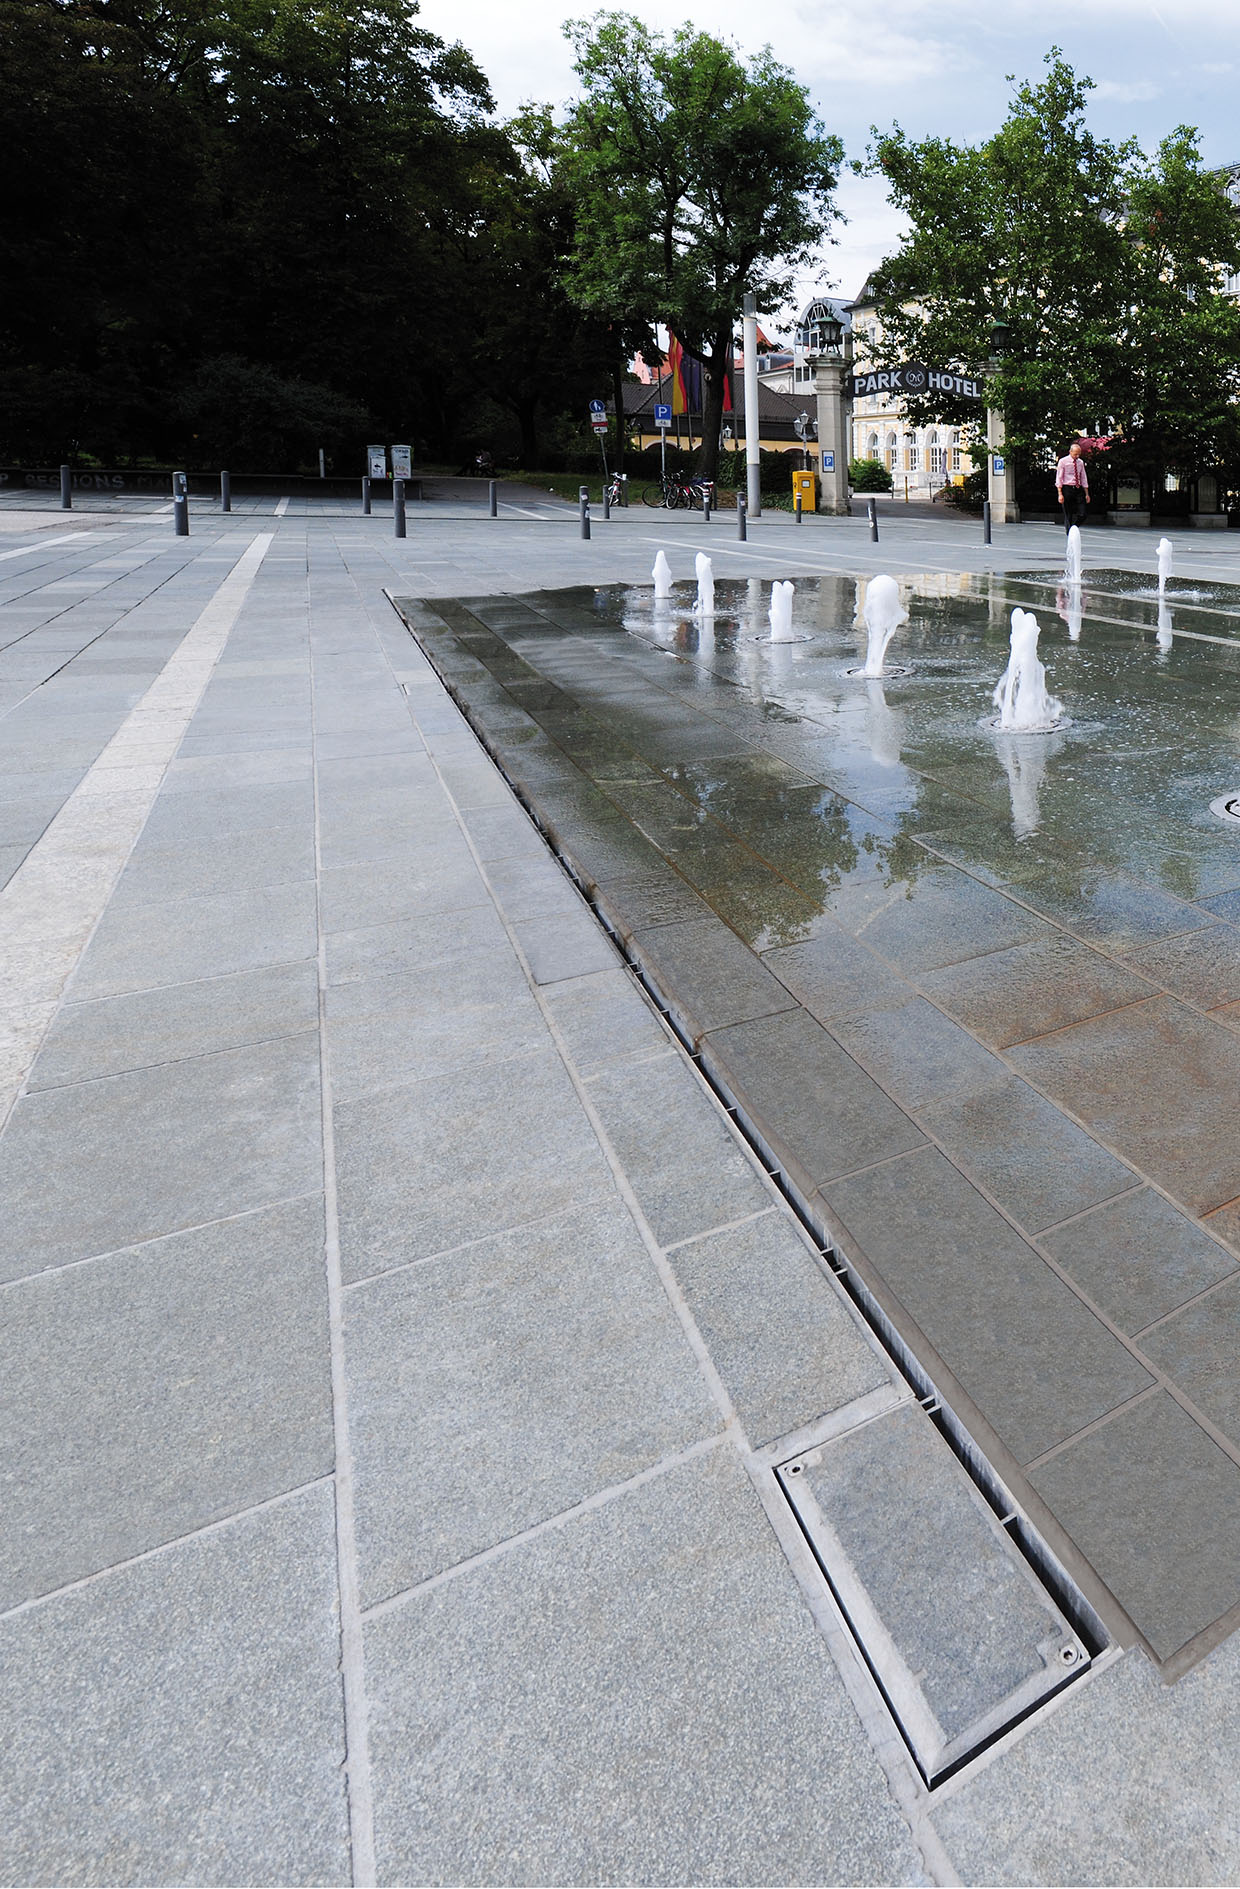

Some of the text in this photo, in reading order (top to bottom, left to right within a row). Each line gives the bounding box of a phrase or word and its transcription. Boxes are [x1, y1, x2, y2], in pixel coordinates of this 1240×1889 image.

[854, 371, 981, 398] PARK HOTEL
[658, 406, 668, 418] P
